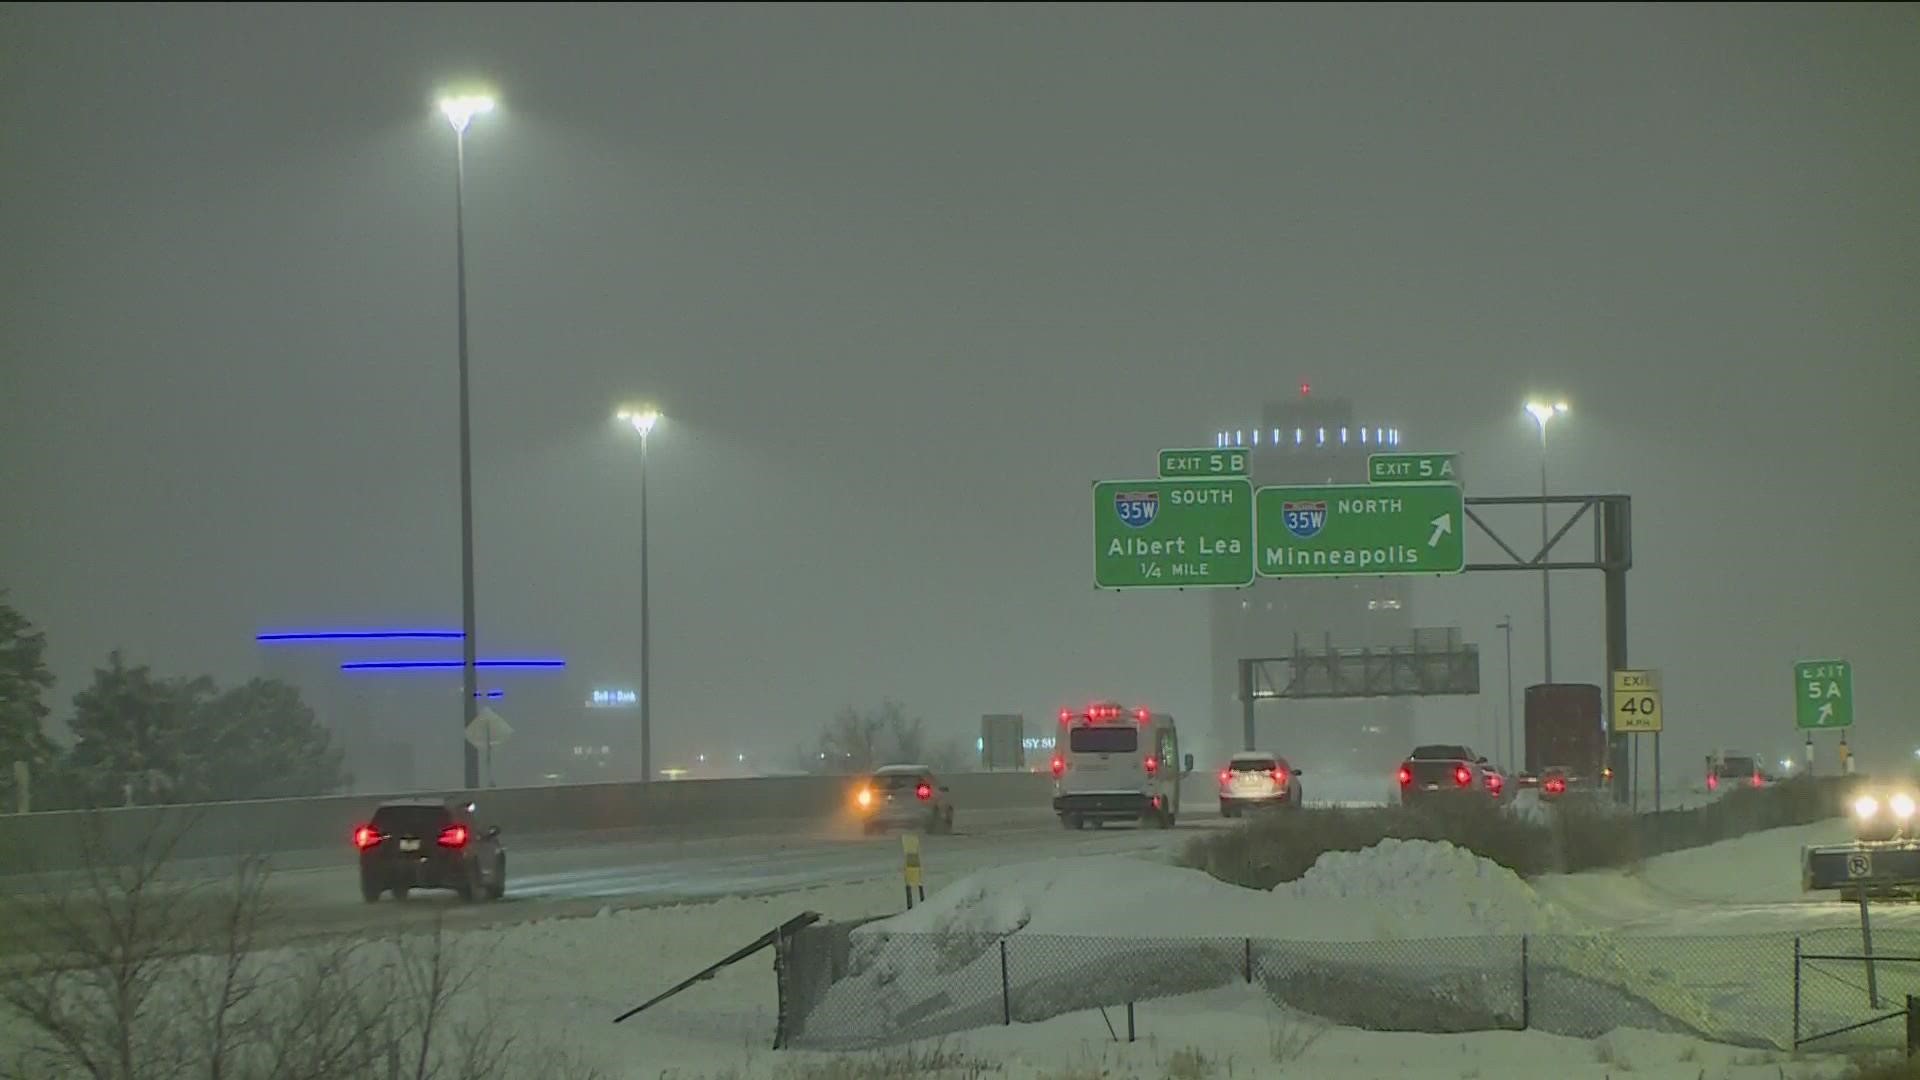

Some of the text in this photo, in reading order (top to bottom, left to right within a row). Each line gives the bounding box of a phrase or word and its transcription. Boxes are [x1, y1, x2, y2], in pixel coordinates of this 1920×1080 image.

[1167, 458, 1201, 470] EXIT
[1375, 463, 1412, 475] EXIT
[1171, 489, 1233, 504] SOUTH
[1120, 502, 1155, 519] 35W
[1338, 499, 1402, 513] NORTH
[1288, 511, 1323, 529] 35W
[1108, 536, 1241, 556] Albert Lea
[1266, 546, 1418, 567] Minneapolis
[1172, 563, 1209, 576] MILE
[1803, 665, 1844, 679] EXIT
[1620, 697, 1655, 716] 40
